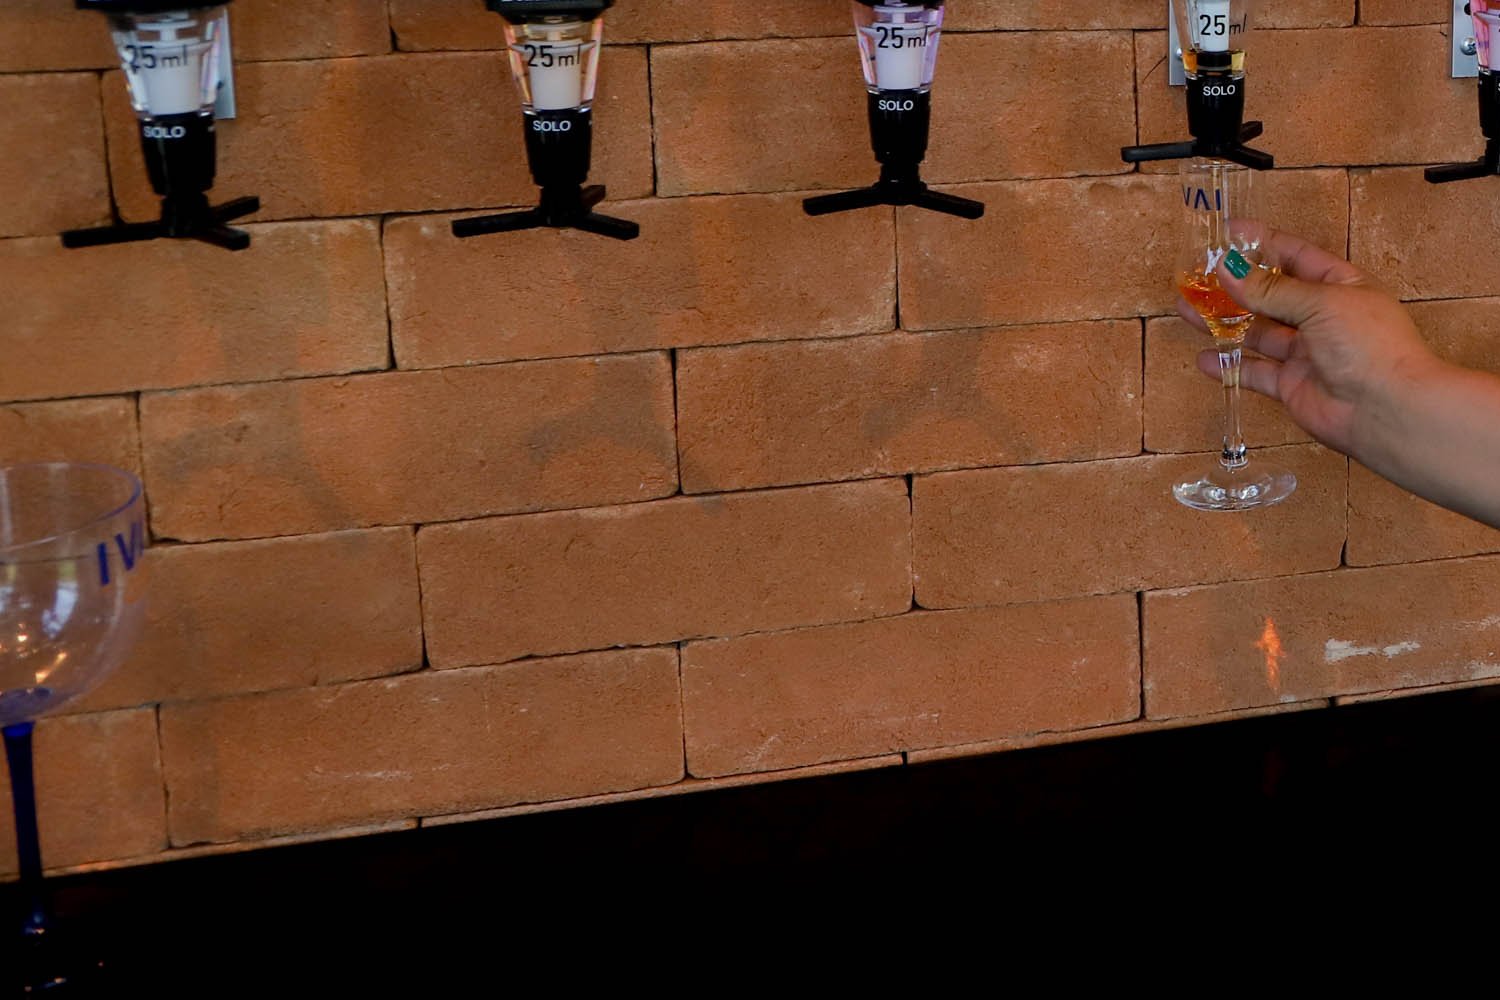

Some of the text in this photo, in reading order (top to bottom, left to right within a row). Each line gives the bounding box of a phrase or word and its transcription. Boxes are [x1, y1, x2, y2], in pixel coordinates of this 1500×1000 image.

[1202, 84, 1236, 96] SOLO
[878, 100, 914, 111] SOLO
[532, 119, 572, 132] SOLO
[142, 125, 187, 139] SOLO
